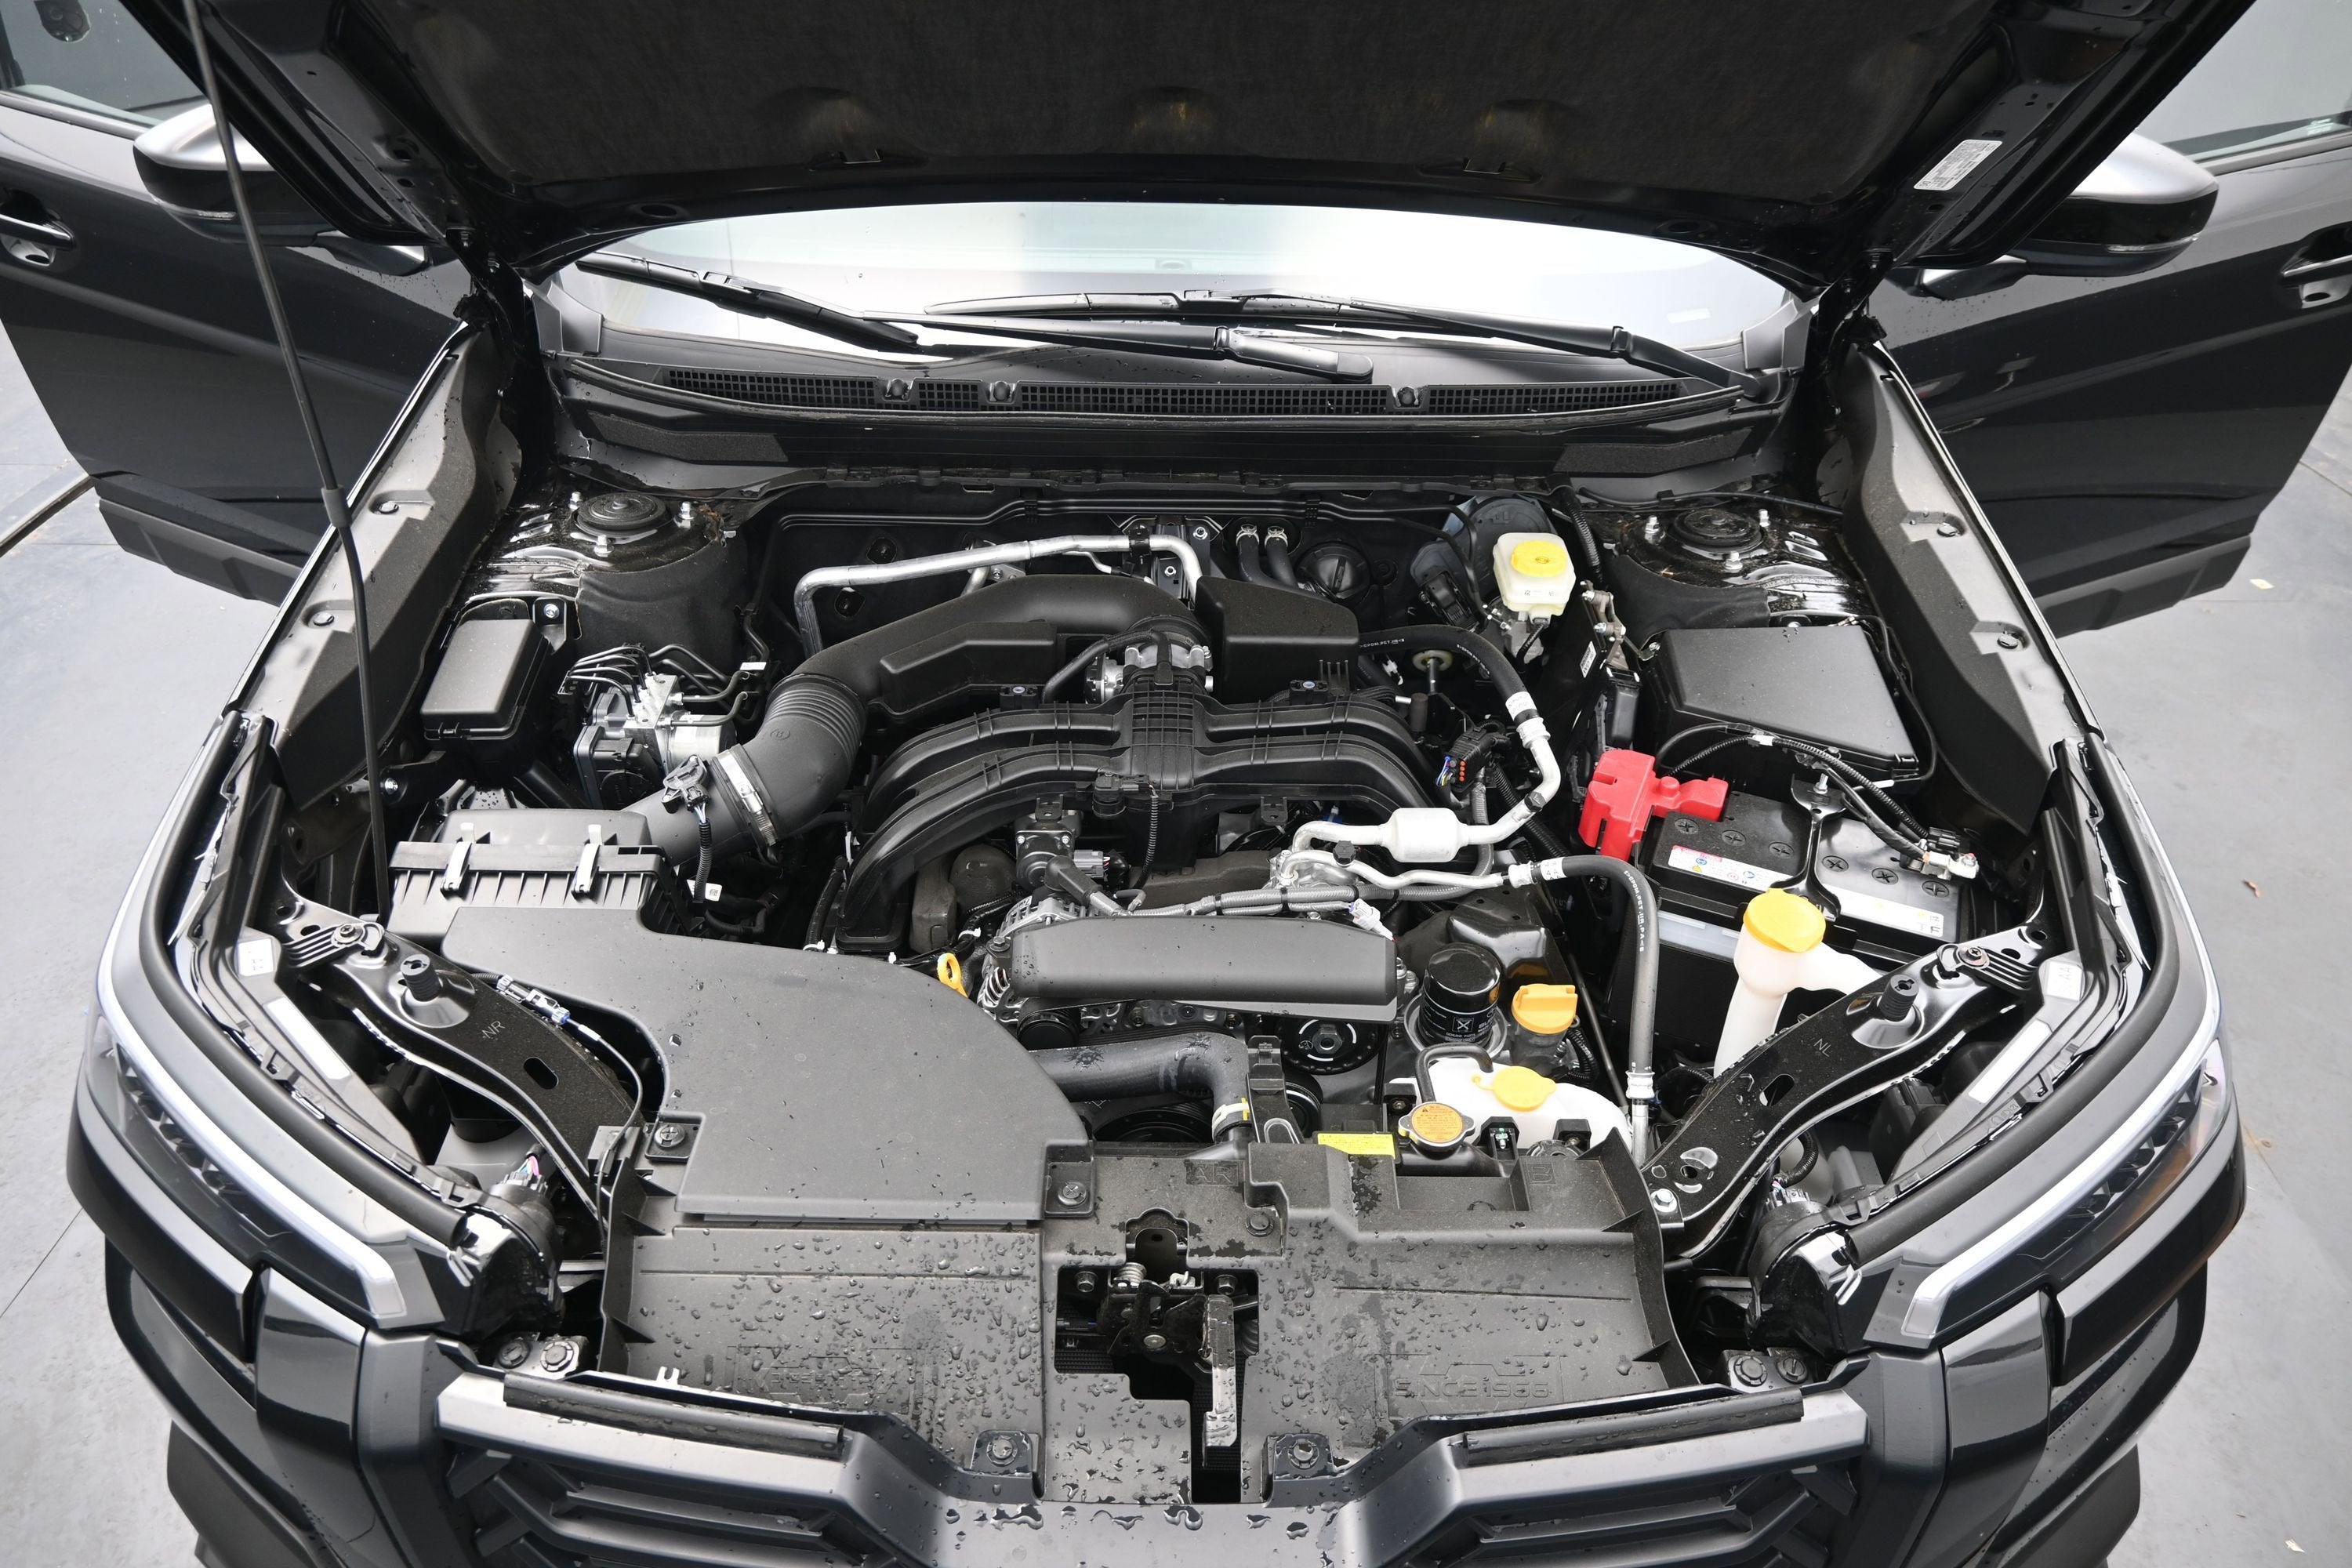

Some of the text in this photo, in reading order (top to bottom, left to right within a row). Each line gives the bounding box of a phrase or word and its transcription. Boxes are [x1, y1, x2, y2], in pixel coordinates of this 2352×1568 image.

[1813, 1038, 1831, 1058] NL
[1396, 1377, 1550, 1398] SINCE 1966
